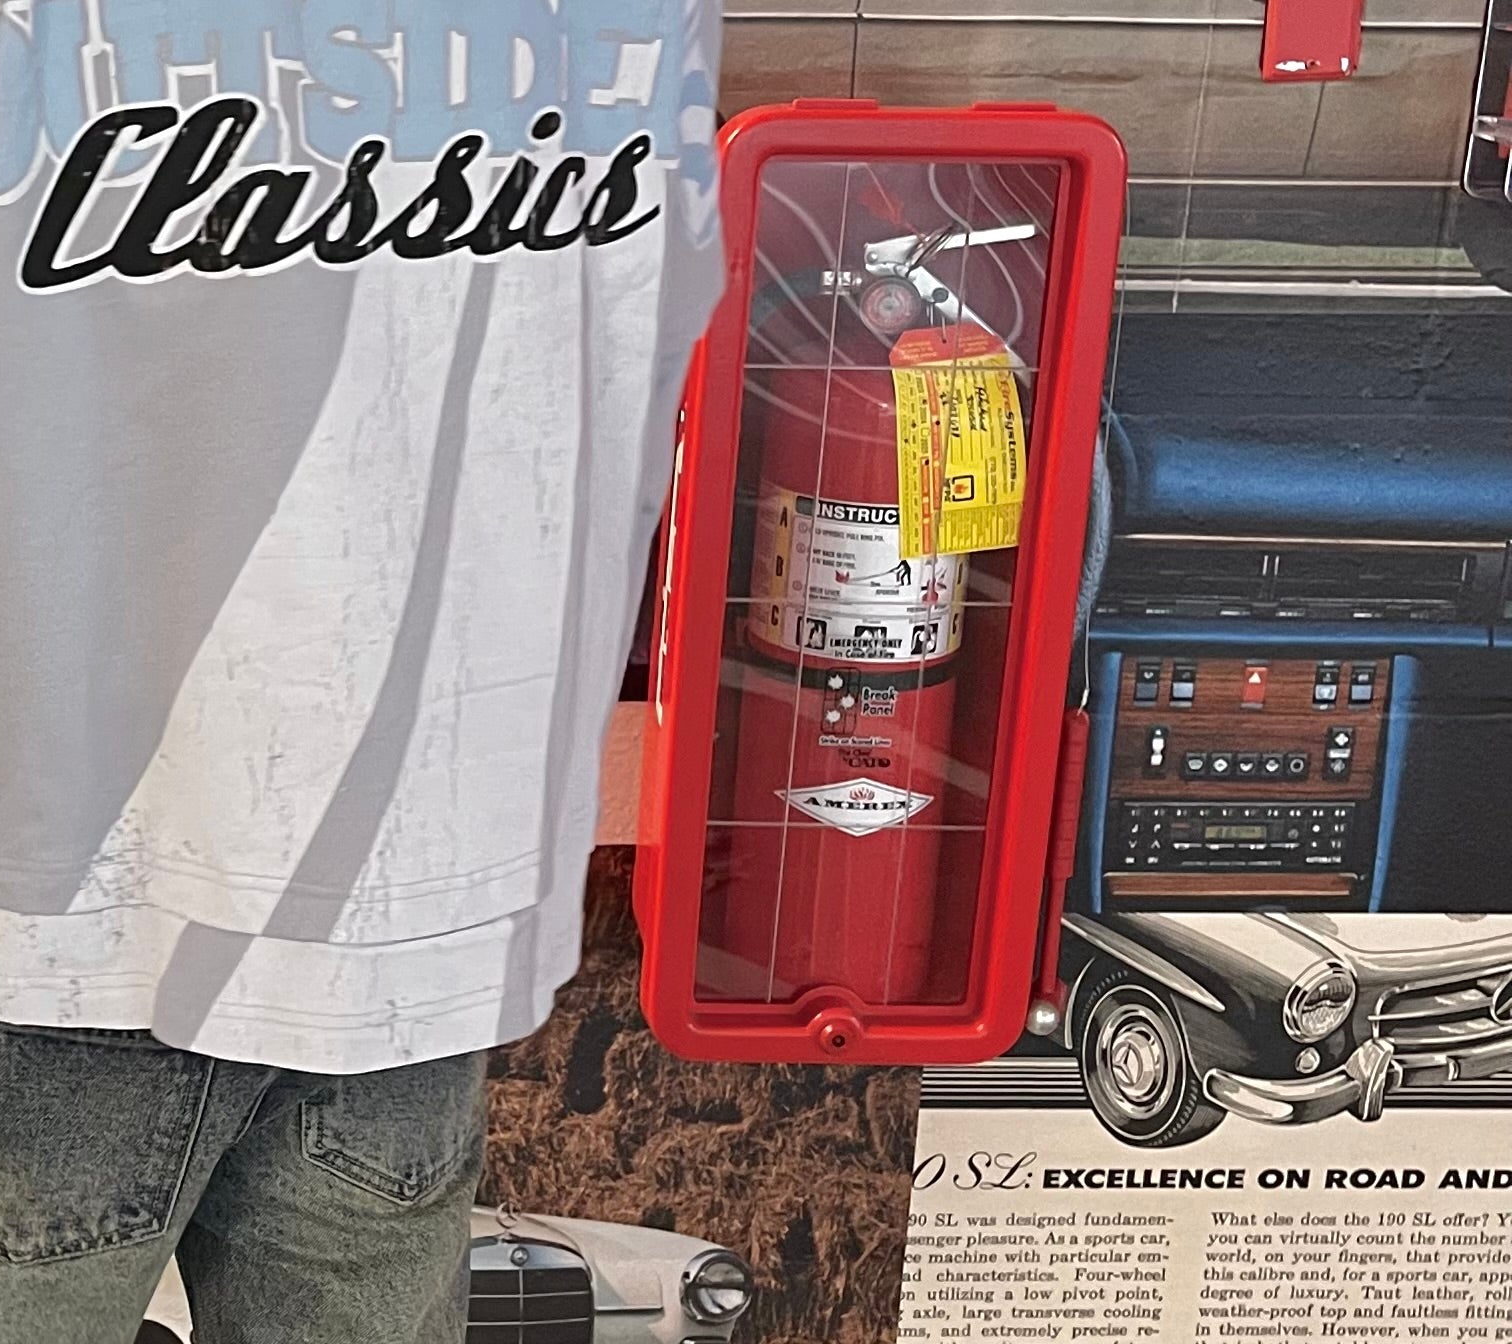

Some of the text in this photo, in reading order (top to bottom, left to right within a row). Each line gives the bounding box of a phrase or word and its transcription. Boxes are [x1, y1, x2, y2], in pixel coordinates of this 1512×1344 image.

[16, 91, 662, 294] Classics
[817, 501, 900, 523] INSTRUC
[863, 686, 895, 700] Break
[863, 703, 894, 715] Panel
[1042, 1168, 1246, 1189] EXCELLENCE
[1257, 1169, 1311, 1189] ON
[1324, 1169, 1426, 1189] ROAD
[1438, 1169, 1512, 1189] AND
[935, 1213, 958, 1227] SL
[967, 1217, 996, 1226] was
[1006, 1212, 1076, 1229] designed
[1212, 1212, 1256, 1226] What
[1264, 1212, 1293, 1226] else
[1301, 1212, 1336, 1226] does
[1344, 1212, 1370, 1226] the
[1379, 1213, 1405, 1226] 190
[1412, 1212, 1436, 1227] SL
[966, 1232, 1170, 1248] pleasure. As a sports car,
[1207, 1231, 1506, 1247] you can virtually count the number
